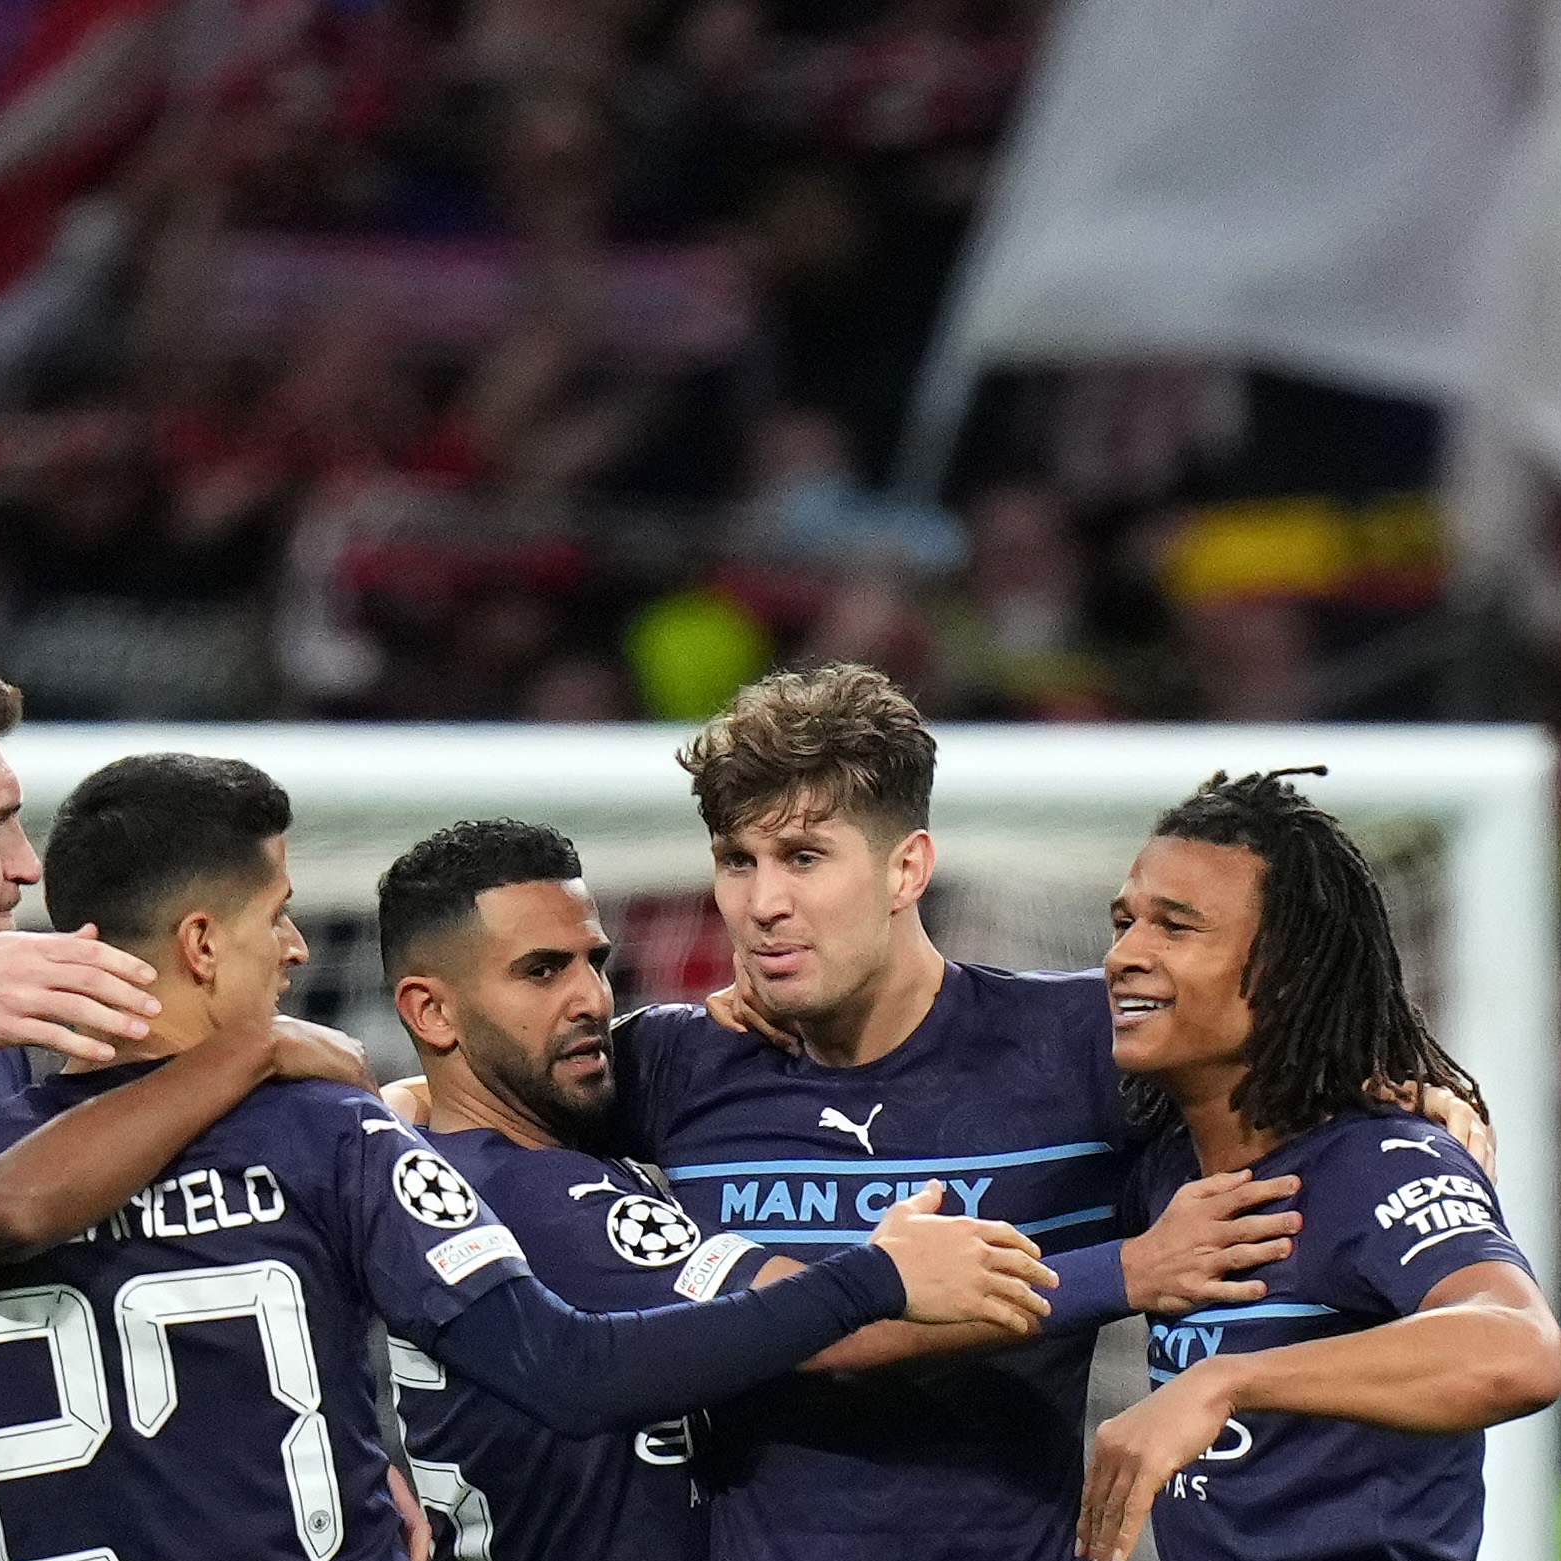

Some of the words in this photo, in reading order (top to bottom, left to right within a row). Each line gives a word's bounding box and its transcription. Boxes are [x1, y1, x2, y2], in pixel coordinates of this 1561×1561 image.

[65, 1165, 286, 1244] NCELO
[720, 1180, 838, 1223] MAN
[1374, 1174, 1492, 1230] NEXEN
[1405, 1199, 1495, 1235] TIRE
